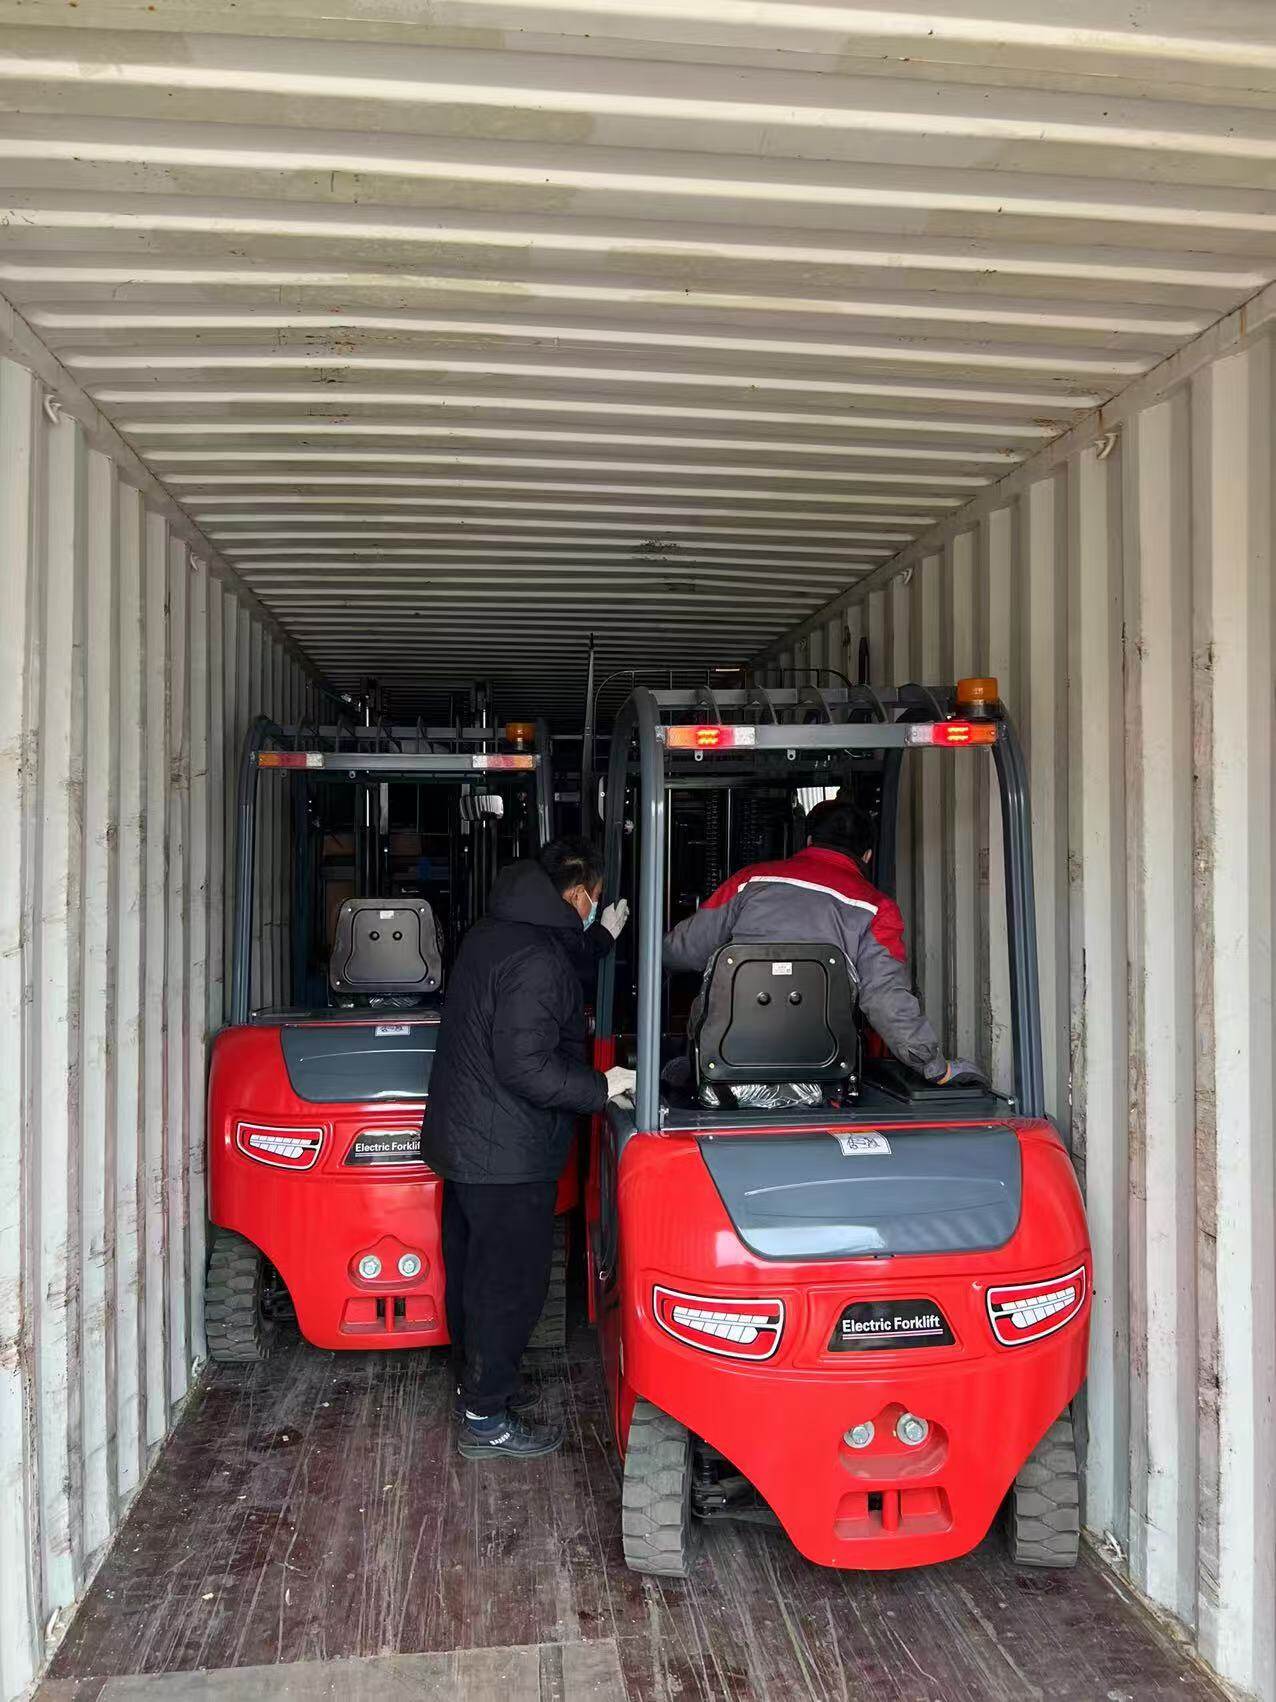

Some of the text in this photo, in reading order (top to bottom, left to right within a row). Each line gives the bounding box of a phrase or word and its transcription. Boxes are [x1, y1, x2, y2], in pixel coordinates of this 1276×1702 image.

[355, 1141, 420, 1152] Electric Forklif
[842, 1315, 940, 1333] Electric Forklift
